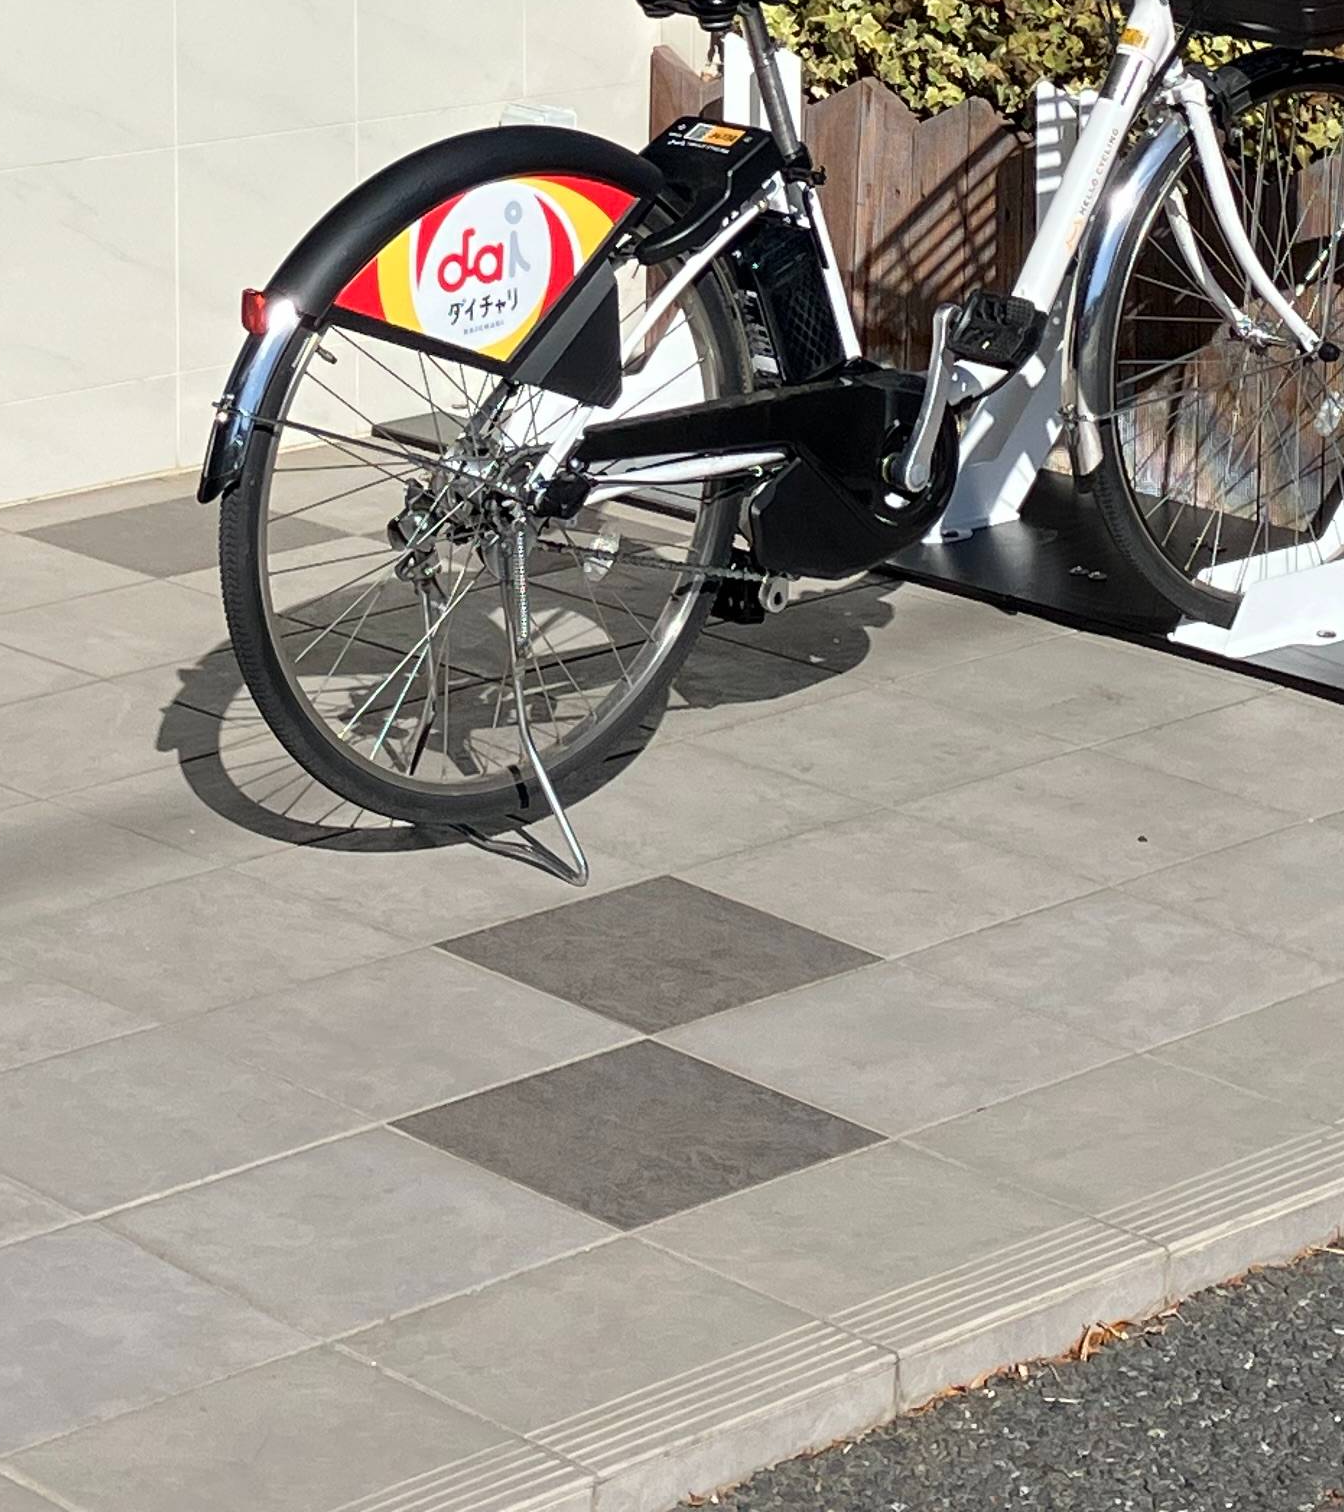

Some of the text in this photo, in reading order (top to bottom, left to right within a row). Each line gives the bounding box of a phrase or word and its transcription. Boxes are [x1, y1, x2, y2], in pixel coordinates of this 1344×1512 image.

[1079, 128, 1119, 216] HELLO CYCLING
[448, 287, 519, 326] ダイチャリ
